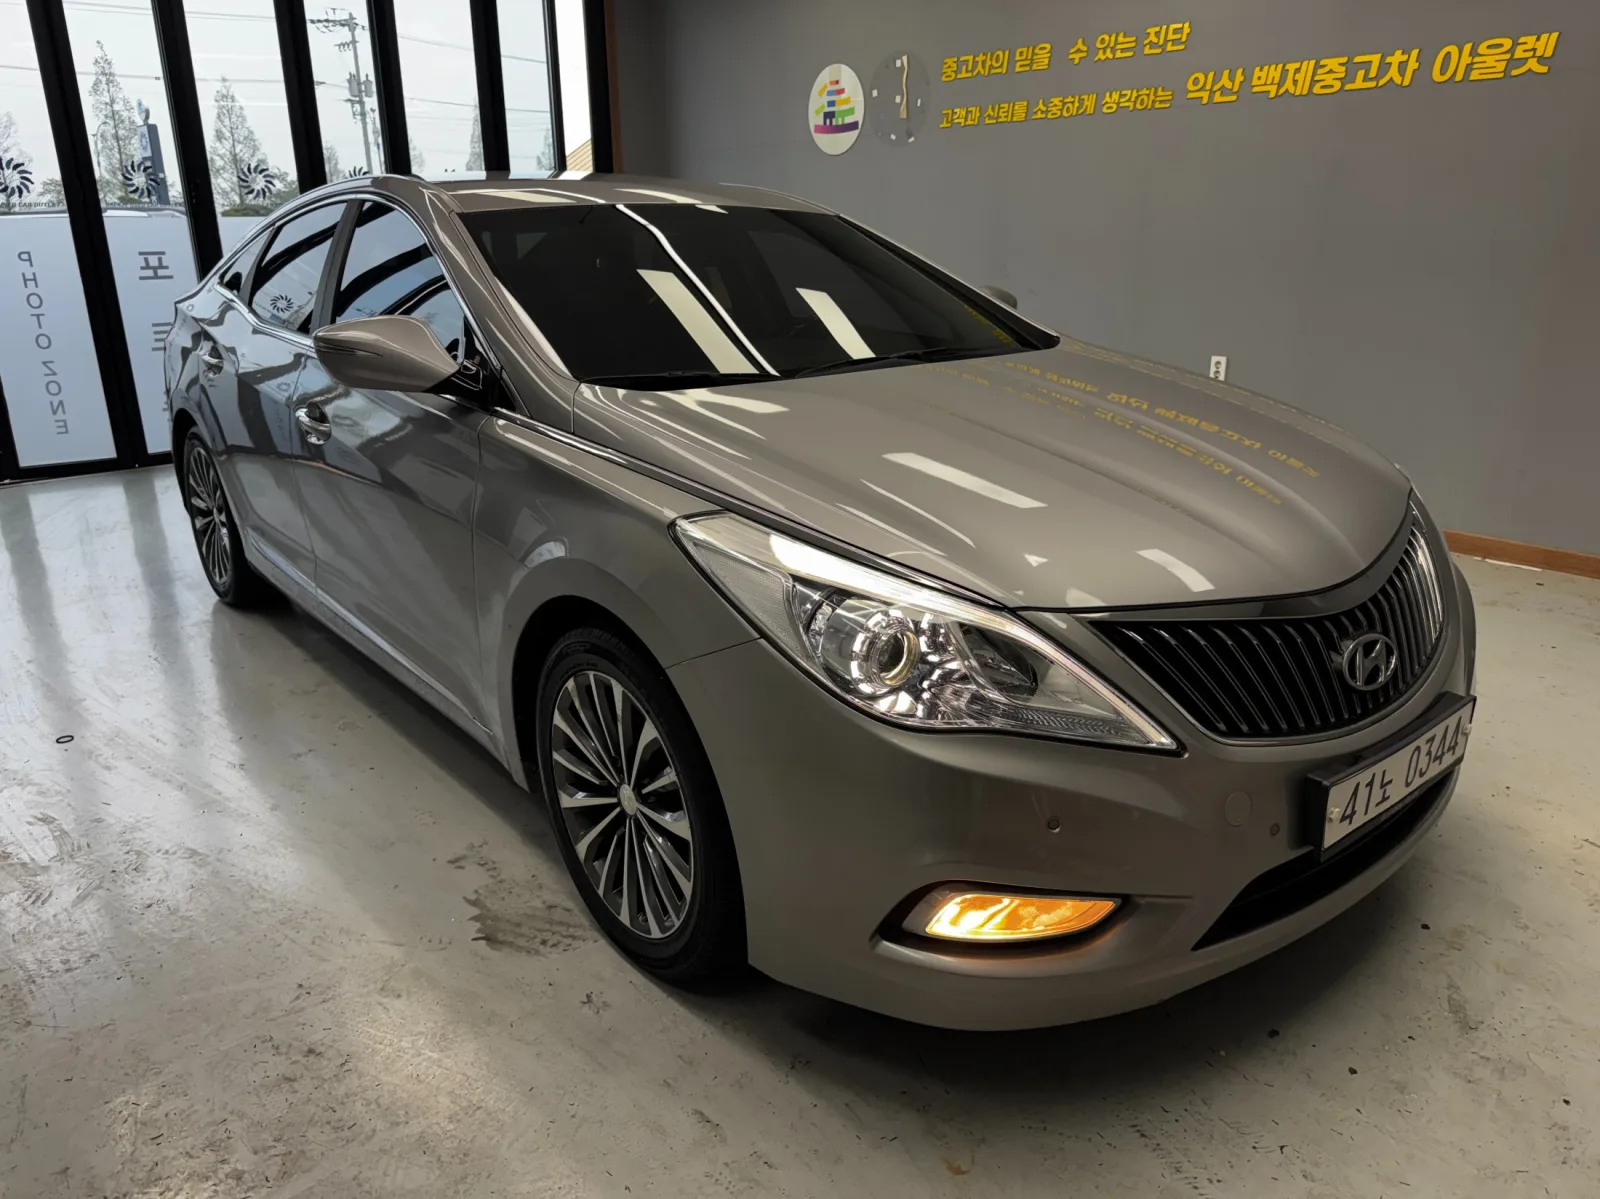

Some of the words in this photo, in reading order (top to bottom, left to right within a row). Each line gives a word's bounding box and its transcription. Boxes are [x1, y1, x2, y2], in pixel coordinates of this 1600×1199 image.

[939, 106, 981, 128] 고객과
[984, 101, 1028, 125] 신뢰를
[1032, 93, 1097, 119] 소중하게
[1101, 86, 1173, 114] 생각하는
[1186, 68, 1245, 105] 익산
[1251, 48, 1420, 100] 백제중고차
[1431, 31, 1560, 84] 아울렛
[941, 48, 1010, 82] 중고차의
[1014, 43, 1052, 73] 믿을
[1068, 36, 1088, 65] 수
[1094, 31, 1137, 62] 있는
[1143, 21, 1191, 55] 진단
[1339, 769, 1393, 825] 41노
[1404, 716, 1462, 788] 0344
